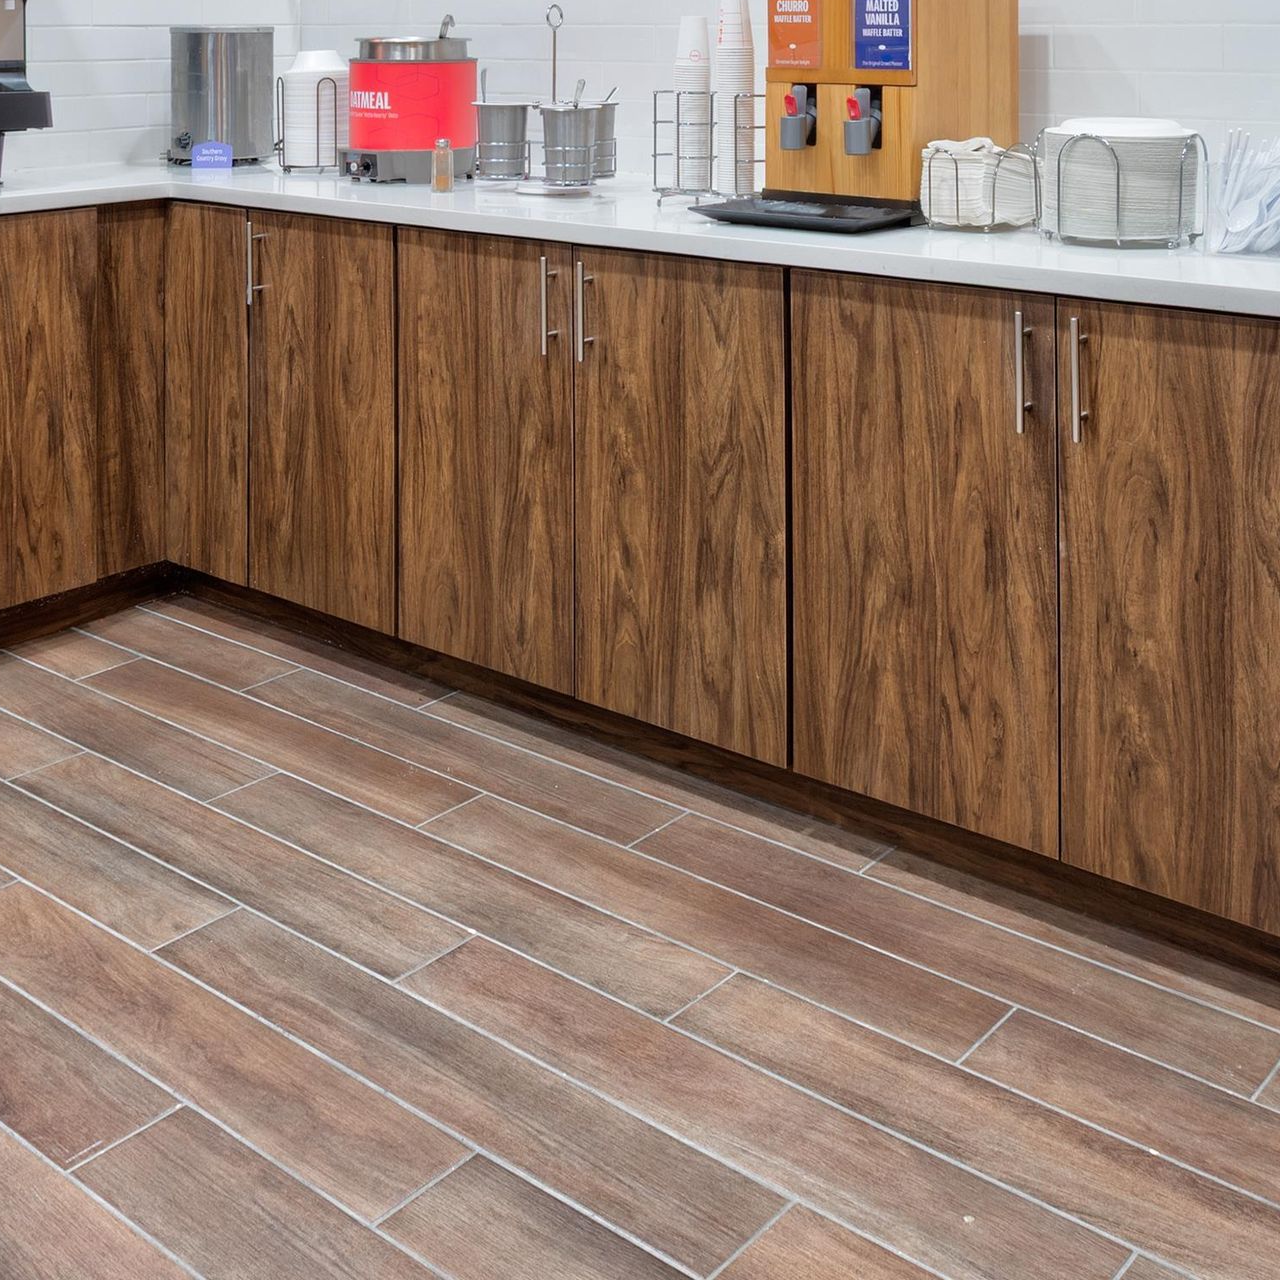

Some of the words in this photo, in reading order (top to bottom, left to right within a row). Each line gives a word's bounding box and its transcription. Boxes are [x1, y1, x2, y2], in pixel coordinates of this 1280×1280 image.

[776, 0, 809, 12] CHURRO
[865, 0, 899, 12] MALTED
[774, 15, 792, 23] WAFFLE
[793, 15, 812, 23] BATTER
[865, 13, 900, 25] VANILLA
[862, 28, 882, 37] WAFFLE
[883, 28, 903, 37] BATTER
